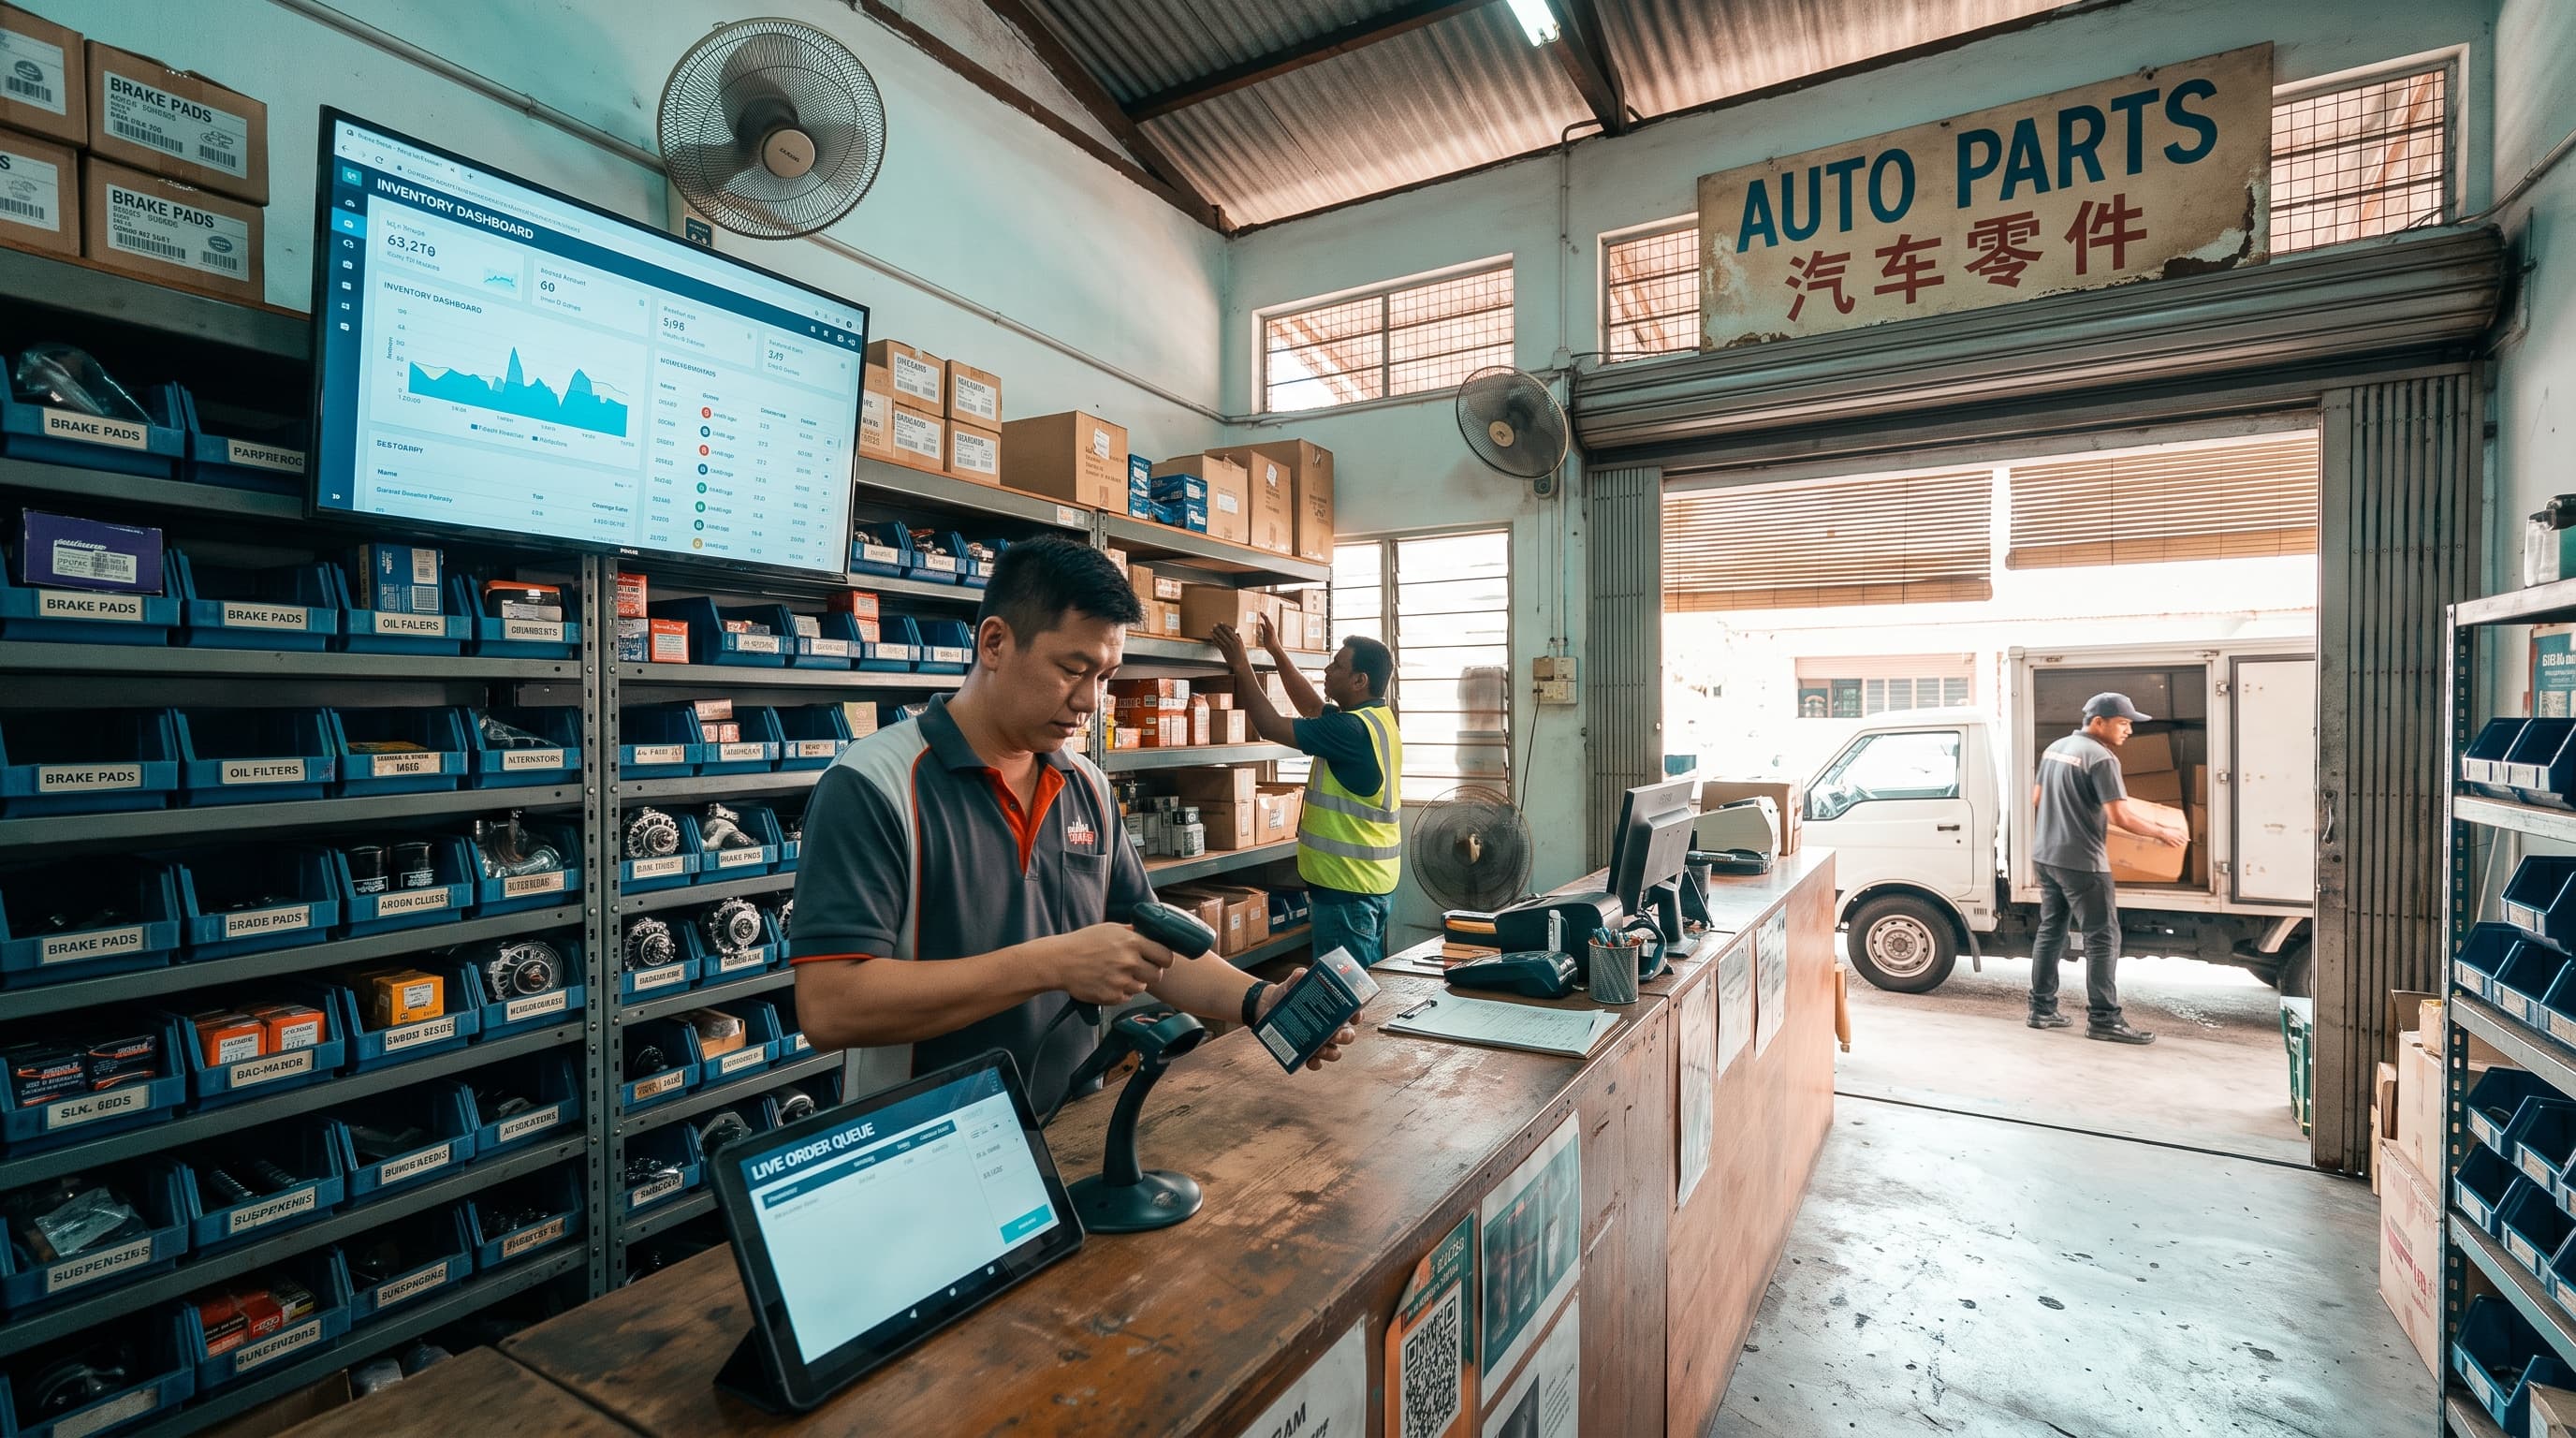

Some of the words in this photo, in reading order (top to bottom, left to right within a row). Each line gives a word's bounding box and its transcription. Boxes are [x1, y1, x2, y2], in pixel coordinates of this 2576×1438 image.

[110, 76, 167, 109] BRAKE
[170, 98, 212, 124] PADS
[1736, 148, 1915, 253] AUTO
[1956, 78, 2218, 209] PARTS
[112, 189, 168, 217] BRAKE
[173, 207, 215, 229] PADS
[376, 177, 455, 213] INVENTORY
[457, 203, 534, 240] DASHBOARD
[1785, 193, 2148, 323] 汽车零件
[384, 281, 432, 301] INVENTORY
[432, 295, 483, 314] DASHBOARD
[540, 280, 555, 293] 60
[51, 418, 99, 435] BRAKE
[104, 425, 140, 442] PADS
[47, 598, 95, 612] BRAKE
[99, 600, 137, 614] PADS
[227, 609, 269, 622] BRAKE
[271, 611, 302, 624] PADS
[382, 618, 400, 629] OIL
[46, 772, 95, 785] BRAKE
[98, 771, 136, 783] PADS
[230, 768, 250, 778] OIL
[253, 765, 300, 776] FILTERS
[272, 912, 302, 925] PADS
[48, 939, 98, 955] BRAKE
[102, 933, 138, 947] PADS
[751, 1153, 786, 1181] LIVE
[785, 1134, 832, 1168] ORDER
[832, 1122, 875, 1151] QUEUE
